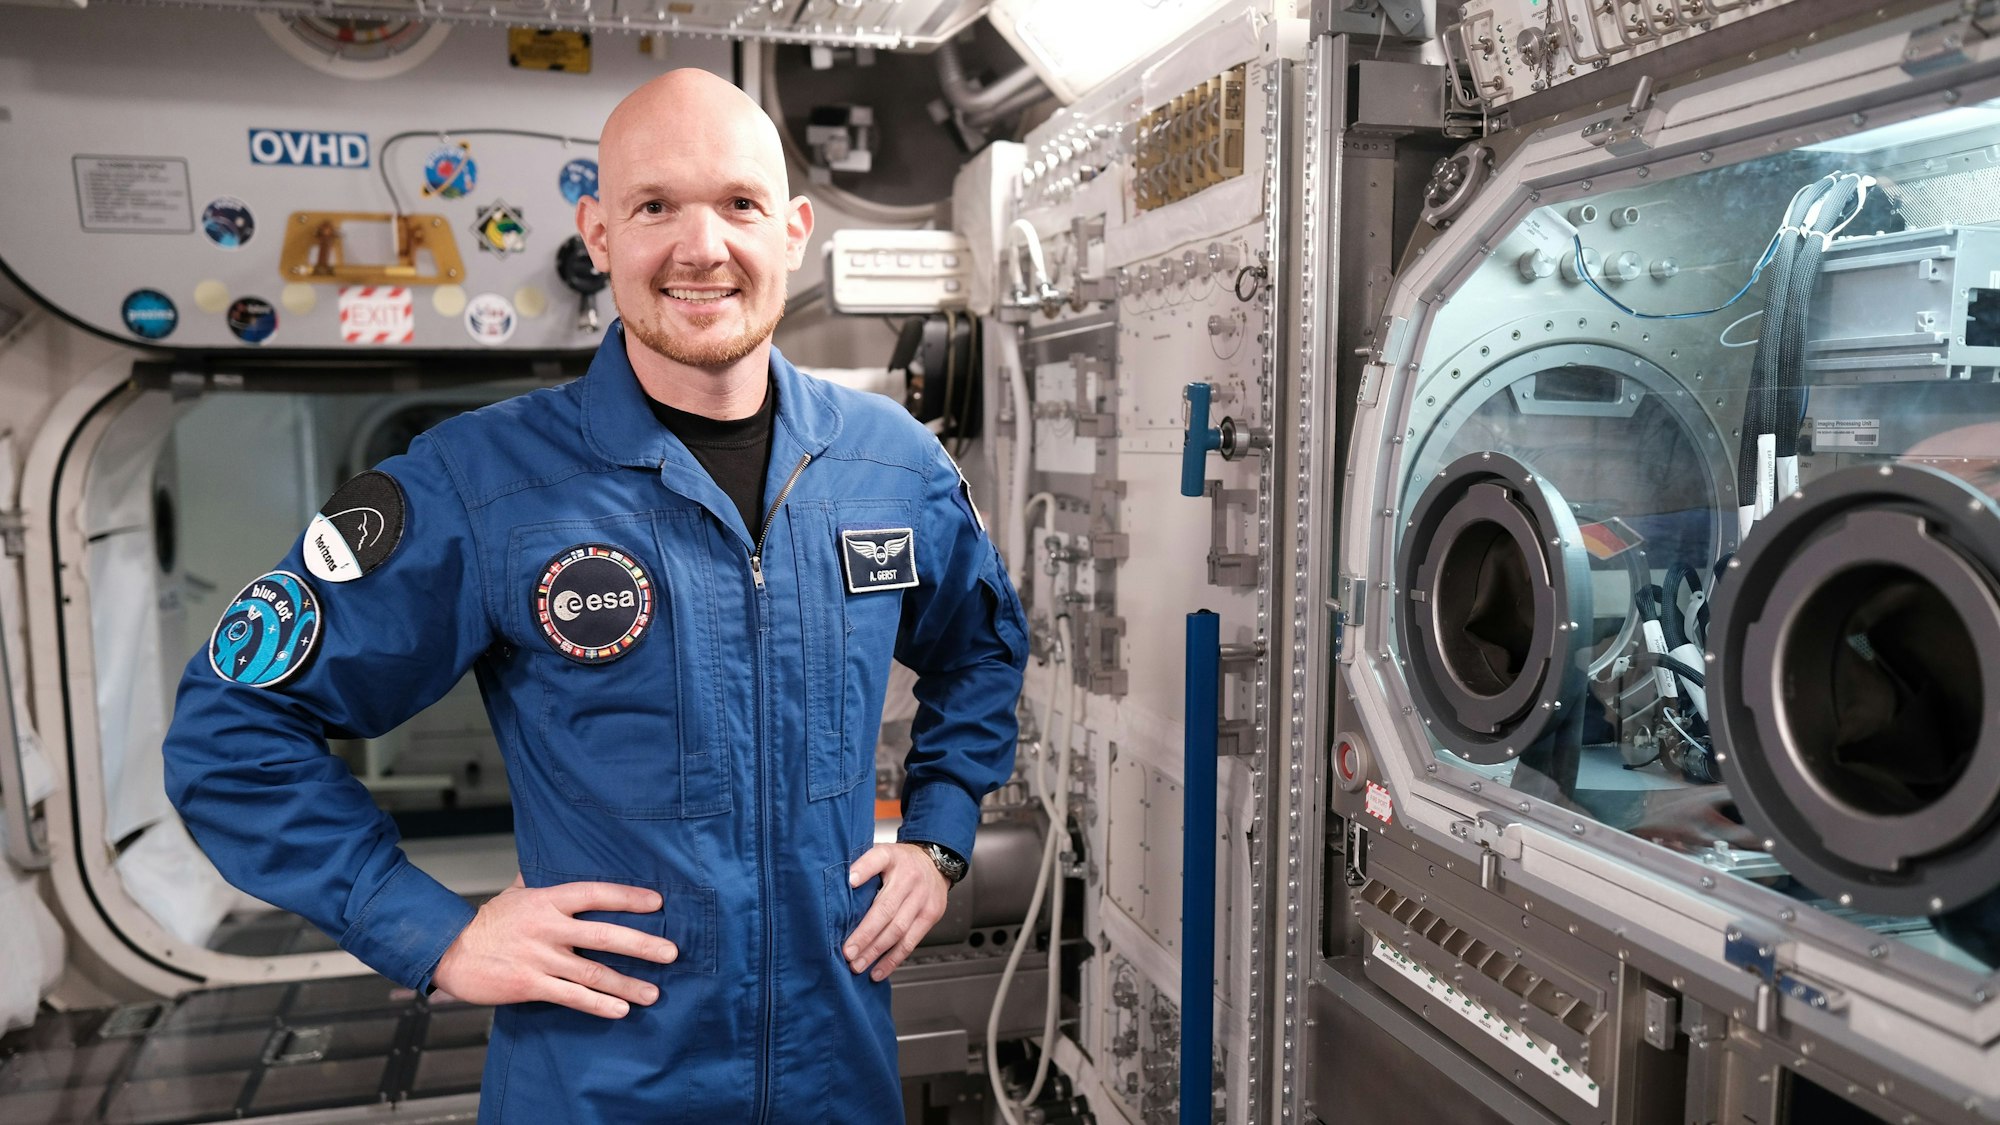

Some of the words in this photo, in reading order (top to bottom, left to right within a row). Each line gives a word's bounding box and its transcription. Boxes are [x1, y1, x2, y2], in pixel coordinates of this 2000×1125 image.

[252, 130, 368, 166] OVHD
[351, 302, 401, 327] EXIT
[314, 533, 338, 572] horizons
[869, 571, 877, 582] A.
[877, 569, 897, 581] GERST
[251, 584, 277, 602] blue
[274, 600, 293, 622] dot
[586, 590, 635, 611] esa
